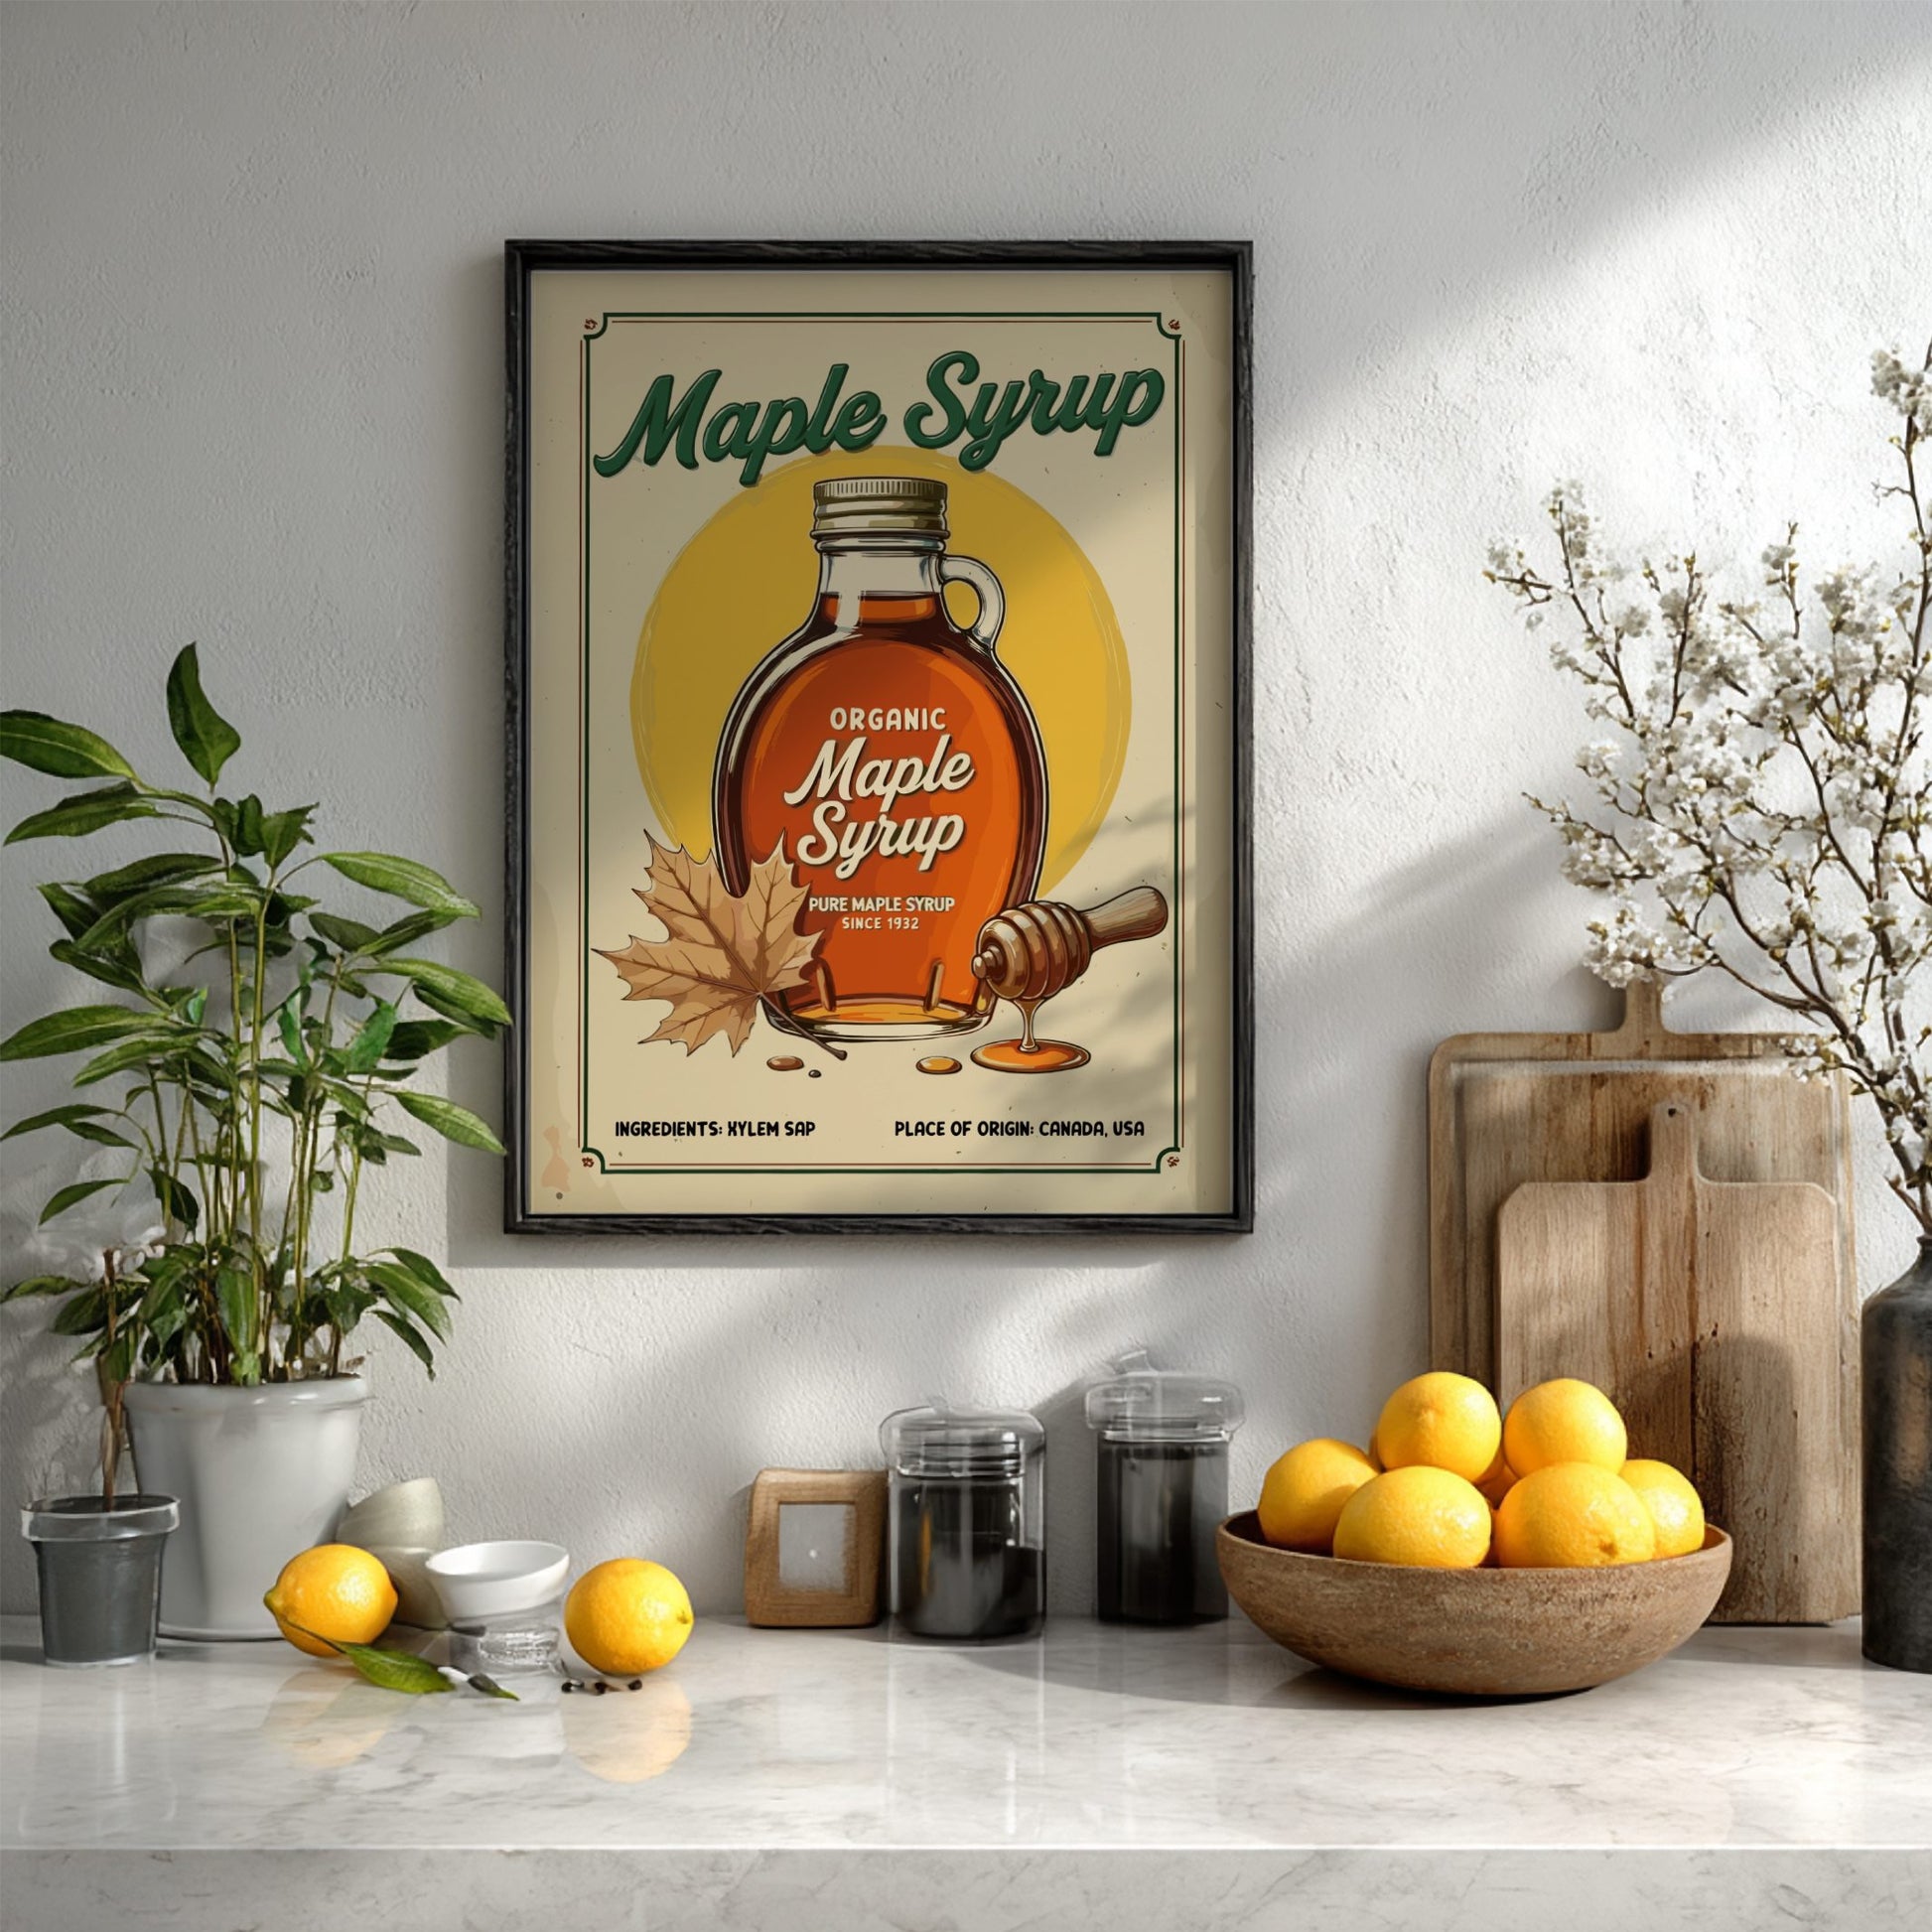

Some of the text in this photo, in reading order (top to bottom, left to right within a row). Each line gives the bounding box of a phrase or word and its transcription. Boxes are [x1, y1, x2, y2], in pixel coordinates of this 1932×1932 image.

[593, 350, 1166, 486] Maple Syrup
[830, 707, 946, 731] ORGANIC
[783, 734, 976, 813] Maple
[796, 800, 965, 881] Syrup
[809, 897, 955, 912] PURE MAPLE SYRUP
[842, 916, 919, 930] SINCE 1932
[615, 1121, 816, 1137] INGREDIENTS: XYLEM SAP
[895, 1120, 1145, 1138] PLACE OF ORIGIN: CANADA, USA
